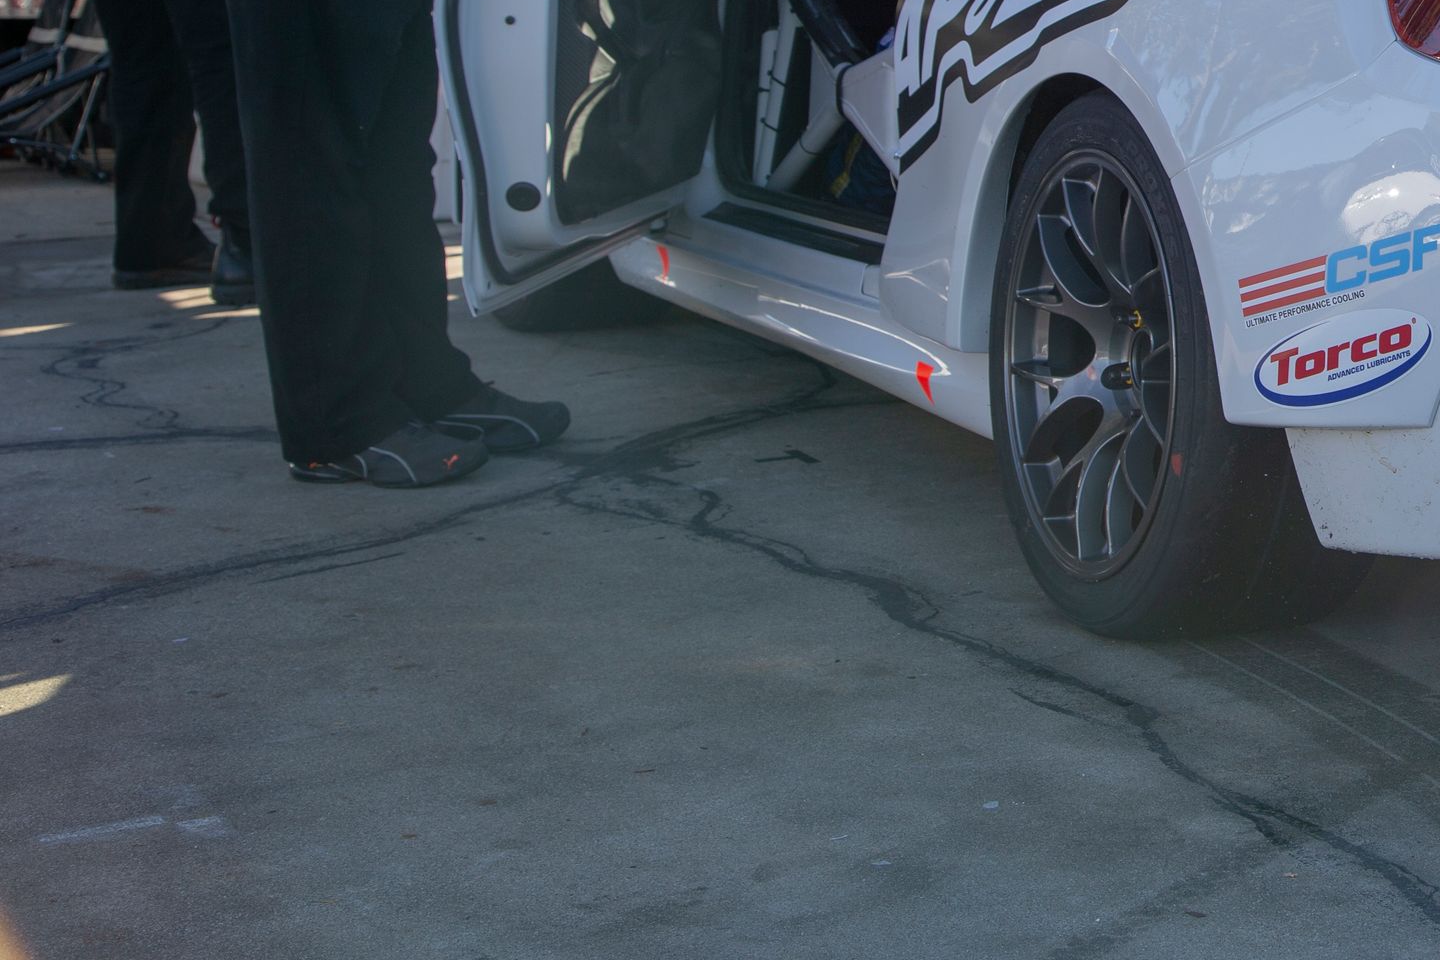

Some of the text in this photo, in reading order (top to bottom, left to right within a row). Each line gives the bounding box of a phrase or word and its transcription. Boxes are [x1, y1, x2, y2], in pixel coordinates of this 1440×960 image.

[1245, 289, 1366, 328] ULTIMATE PERFORMANCE COOLING
[1270, 323, 1412, 387] Torco
[1327, 349, 1411, 382] ADVANCED LUBRICANTS
